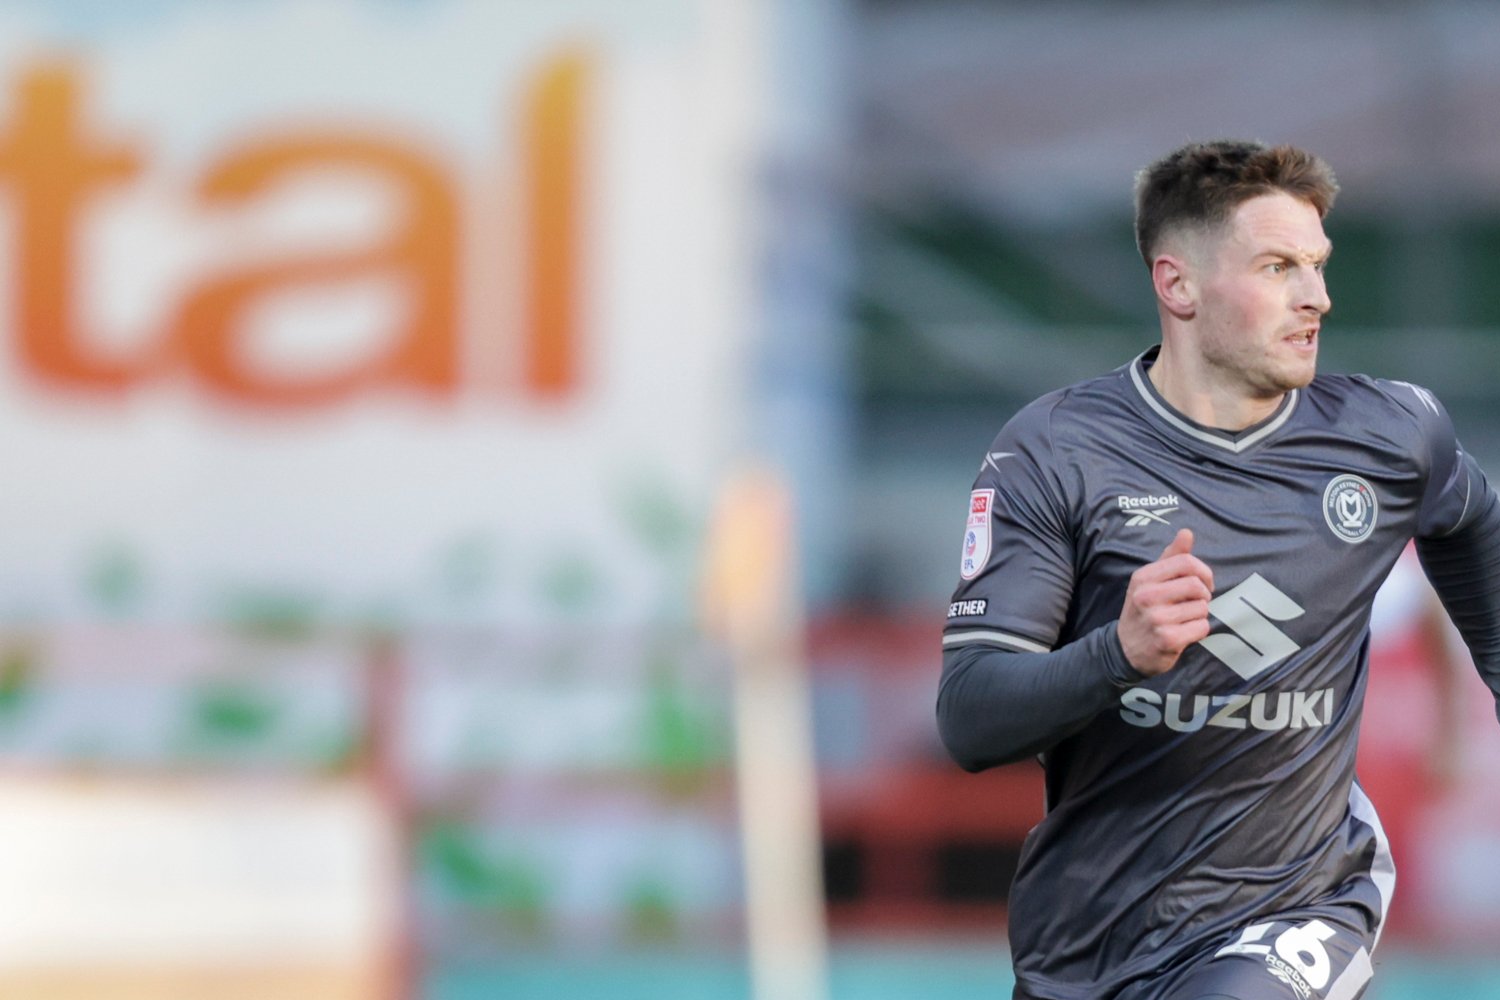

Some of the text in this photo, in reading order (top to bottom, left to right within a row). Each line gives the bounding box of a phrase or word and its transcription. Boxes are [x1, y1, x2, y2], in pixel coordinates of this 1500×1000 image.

[1117, 494, 1179, 509] Reebok
[1119, 687, 1335, 733] SUZUKI
[1265, 953, 1312, 999] Reebok
